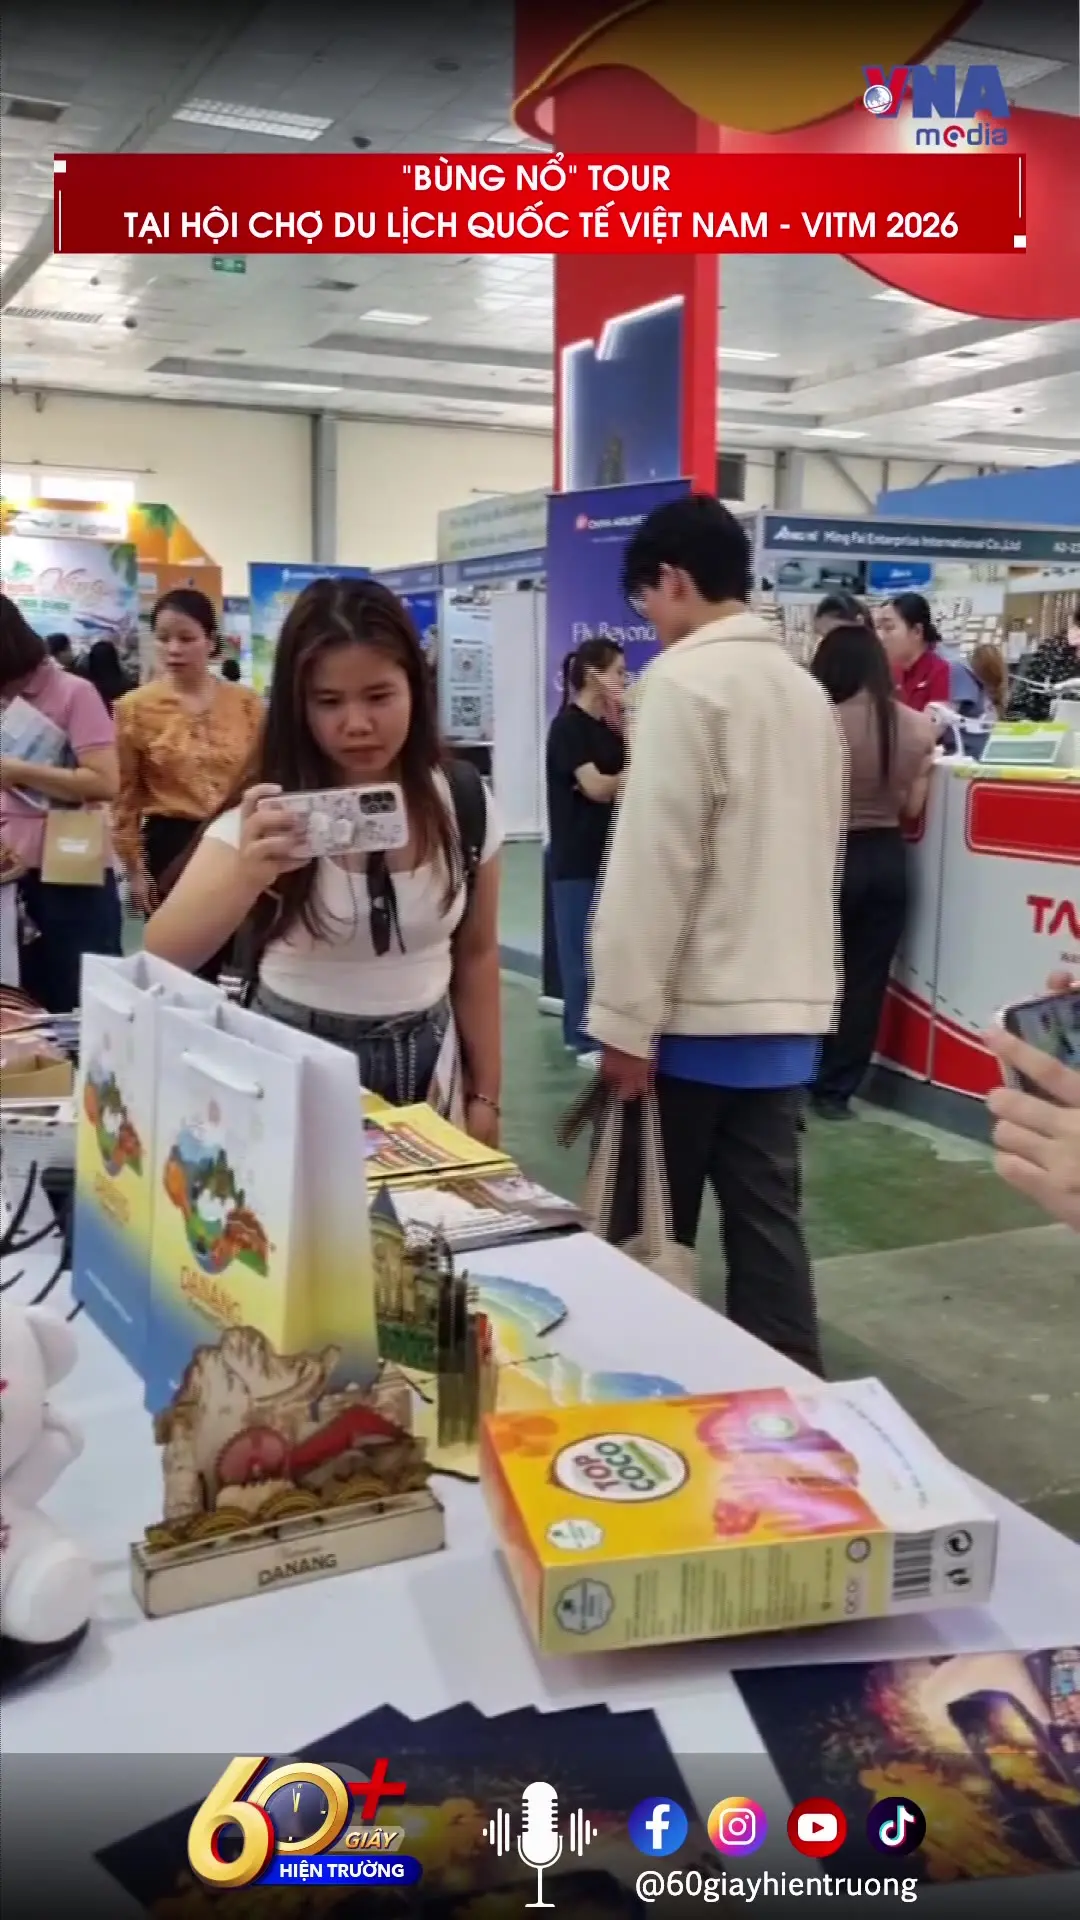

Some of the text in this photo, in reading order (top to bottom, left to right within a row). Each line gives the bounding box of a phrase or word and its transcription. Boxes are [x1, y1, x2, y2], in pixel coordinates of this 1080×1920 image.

[573, 1455, 619, 1491] TOP
[595, 1441, 656, 1491] COCO
[258, 1553, 337, 1588] DANANG
